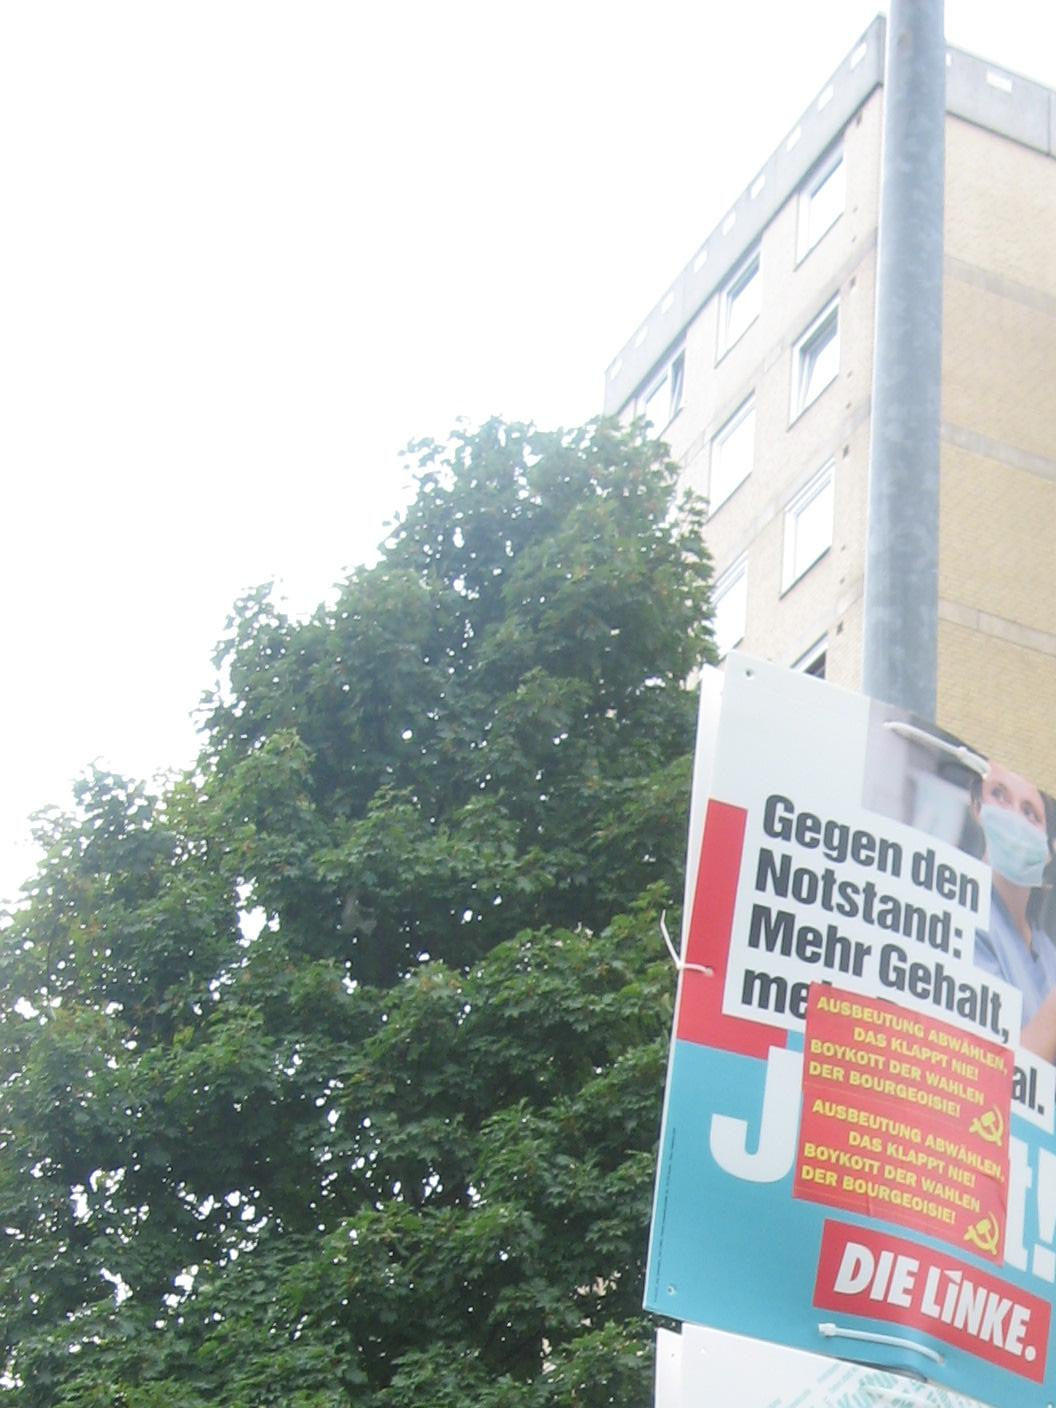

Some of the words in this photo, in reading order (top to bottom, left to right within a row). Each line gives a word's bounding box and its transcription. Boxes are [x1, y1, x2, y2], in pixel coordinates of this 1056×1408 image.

[763, 794, 903, 878] Gegen
[911, 849, 979, 913] den
[755, 847, 964, 959] Notstand:
[748, 903, 871, 977] Mehr
[878, 943, 1010, 1044] Gehalt,
[810, 1038, 886, 1070] BOYKOTT
[889, 1059, 922, 1083] DER
[925, 1071, 985, 1105] WAHLEN
[817, 996, 925, 1038] AUSBEUTUNG
[927, 1027, 1009, 1075] ABWÄHLEN,
[854, 1026, 887, 1048] DAS
[891, 1038, 948, 1068] KLAPPT
[951, 1058, 979, 1081] NIE!
[809, 1060, 845, 1083] DER
[849, 1070, 961, 1118] BOURGEOISIE!
[804, 1142, 881, 1175] BOYKOTT
[884, 1163, 917, 1188] DER
[921, 1176, 981, 1213] WAHLEN
[812, 1098, 922, 1144] AUSBEUTUNG
[925, 1133, 1006, 1183] ABWÄHLEN,
[848, 1131, 884, 1153] DAS
[886, 1142, 945, 1175] KLAPPT
[948, 1164, 976, 1189] NIE!
[801, 1164, 838, 1188] DER
[842, 1176, 957, 1225] BOURGEOISIE!
[833, 1241, 919, 1308] DIE
[920, 1266, 1037, 1362] LINKE.
